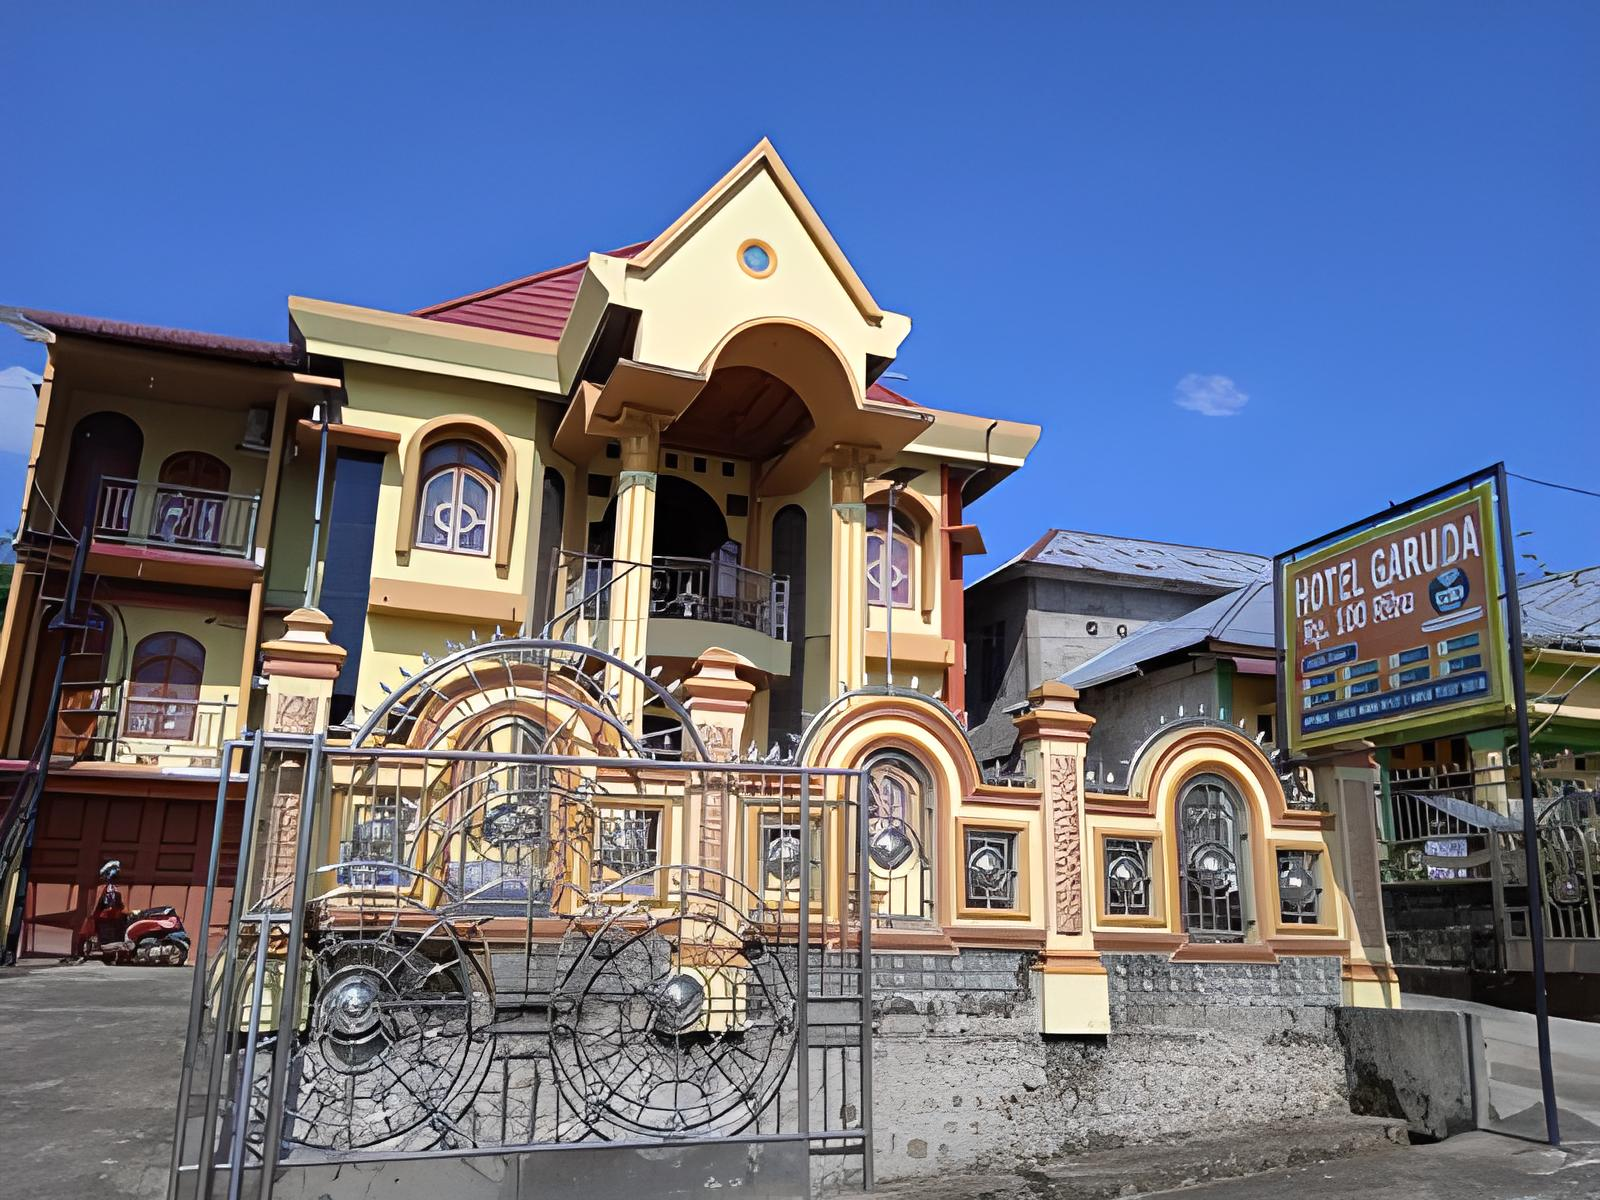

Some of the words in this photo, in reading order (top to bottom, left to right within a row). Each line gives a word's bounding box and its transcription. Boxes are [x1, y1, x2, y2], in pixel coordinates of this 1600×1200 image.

[1295, 558, 1364, 618] HOTEL
[1371, 514, 1480, 590] GARUDA
[1336, 600, 1367, 635] 100
